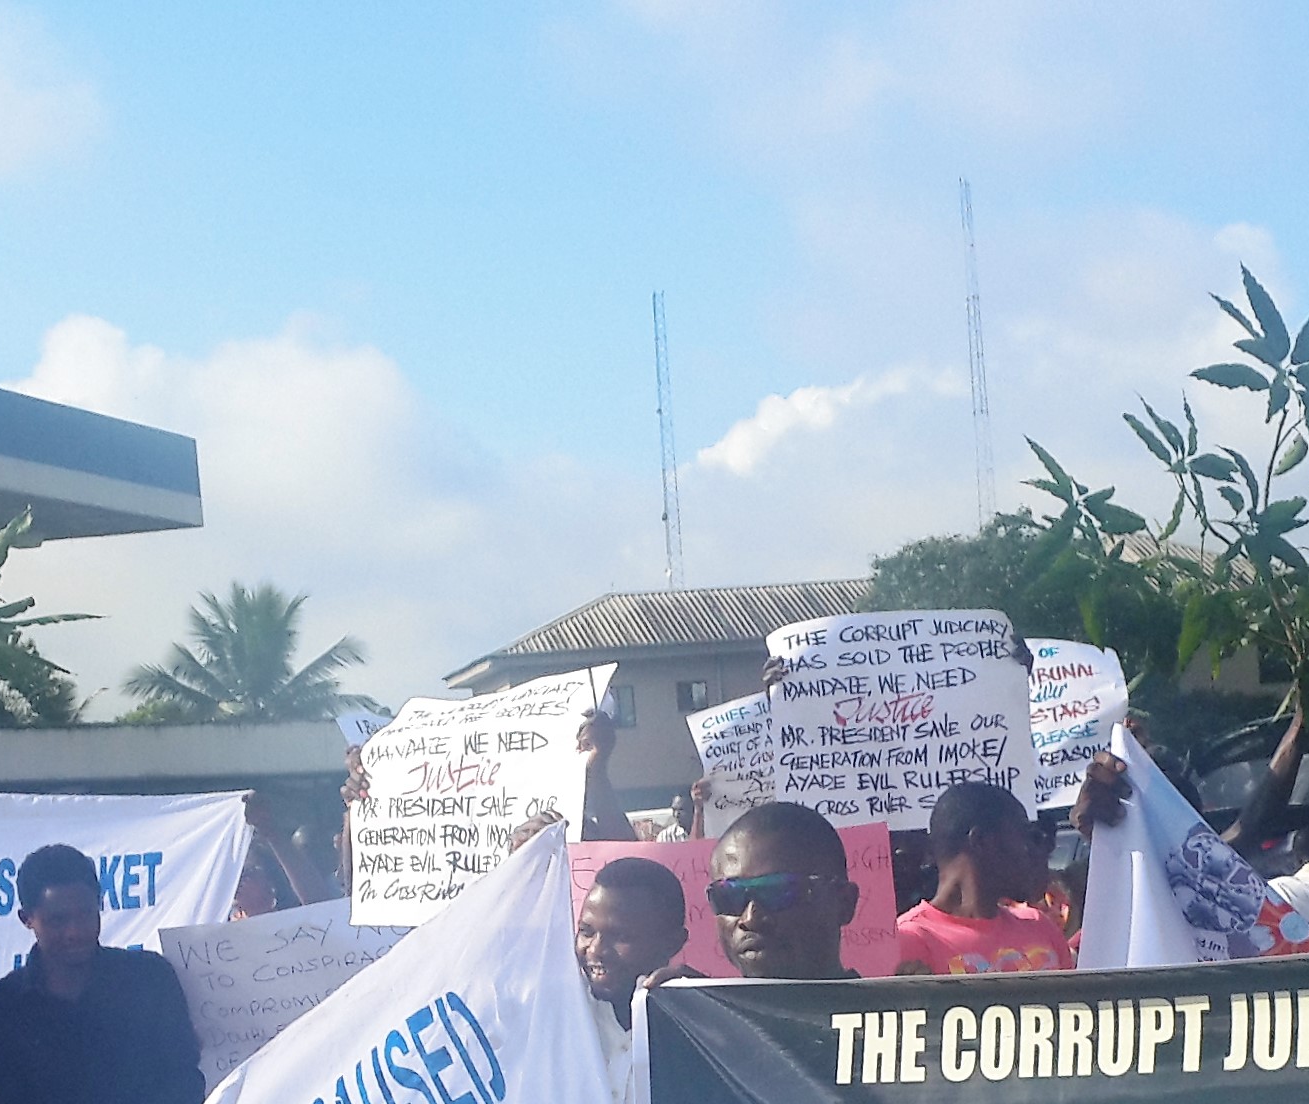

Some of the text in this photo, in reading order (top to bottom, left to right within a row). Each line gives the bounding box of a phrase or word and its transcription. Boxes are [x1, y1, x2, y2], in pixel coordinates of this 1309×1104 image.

[784, 618, 1008, 650] THE CORRUPT JUDICIARY
[836, 648, 890, 668] SOLD
[898, 643, 934, 665] THE
[915, 666, 977, 690] NEED
[702, 706, 750, 729] CHIEF
[1030, 696, 1100, 725] STARS
[463, 731, 489, 755] WE
[498, 731, 549, 754] NEED
[781, 723, 814, 749] MR.
[818, 722, 910, 746] PRESIDENT
[914, 712, 960, 739] SAVE
[970, 712, 1008, 732] OUR
[1030, 719, 1099, 748] PLEASE
[706, 741, 741, 759] COURT
[780, 748, 882, 771] GENERATION
[885, 745, 928, 768] FROM
[785, 773, 846, 793] AYADE
[856, 771, 898, 791] EVIL
[389, 796, 476, 818] PRESIDENT
[476, 787, 517, 818] SAVE
[868, 792, 913, 817] RIVER
[358, 825, 479, 848] GENERATION FROM
[358, 855, 404, 875] AYADE
[409, 853, 442, 874] EVIL
[177, 939, 240, 970] WE
[266, 918, 333, 954] SAY
[198, 943, 395, 991] TO CONSPIRAC
[831, 1005, 929, 1087] THE
[939, 991, 1212, 1084] CORRUPT
